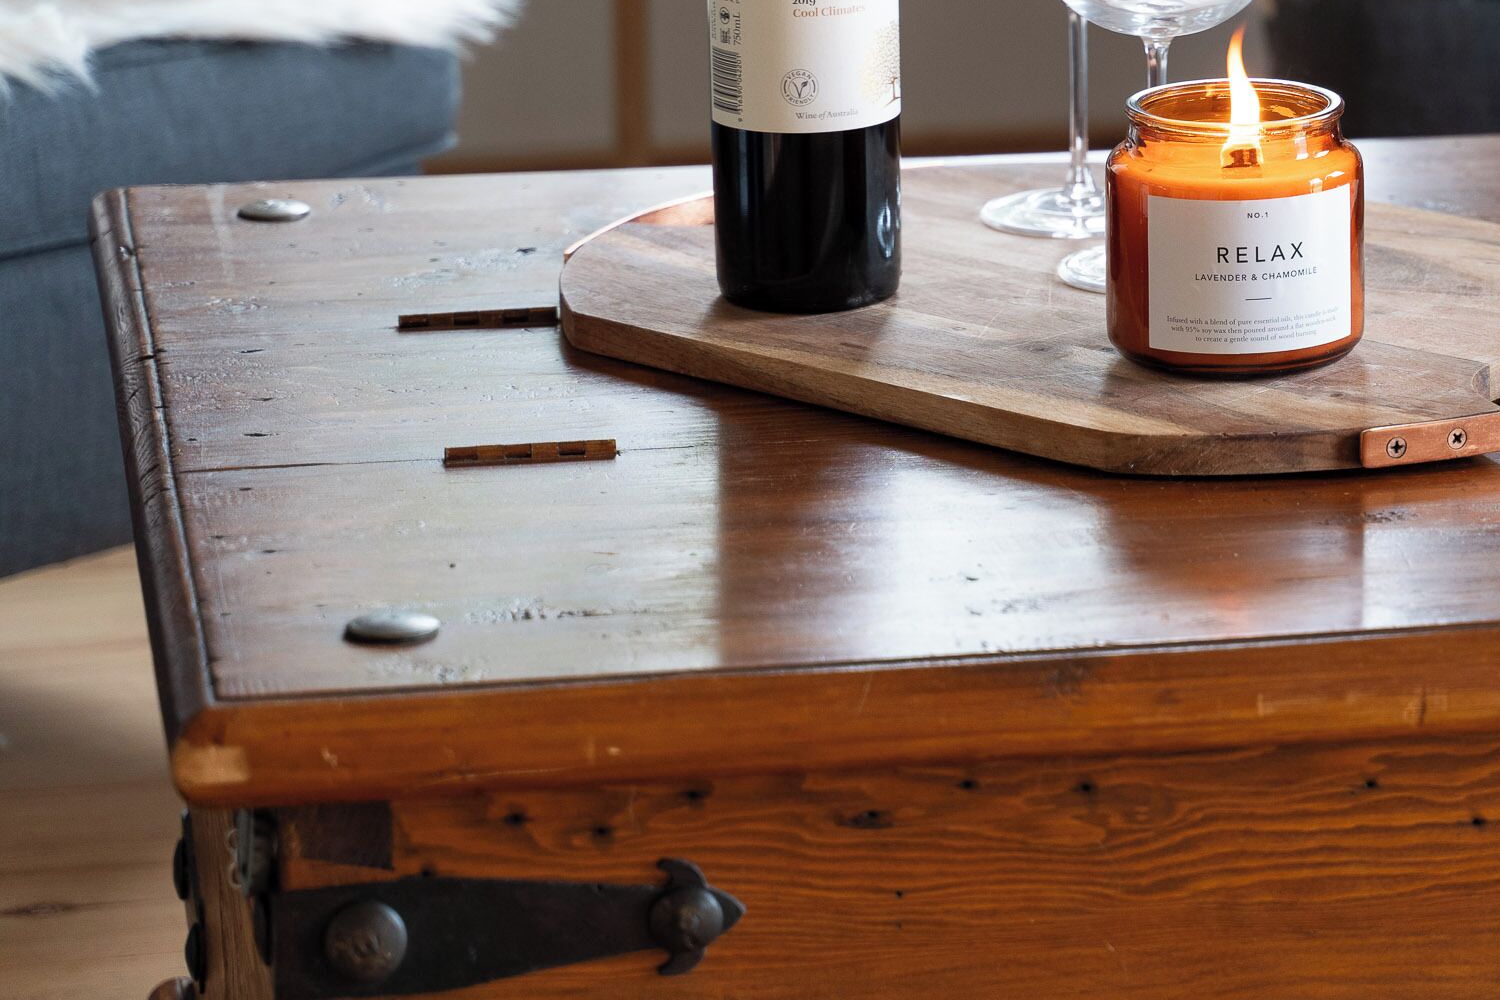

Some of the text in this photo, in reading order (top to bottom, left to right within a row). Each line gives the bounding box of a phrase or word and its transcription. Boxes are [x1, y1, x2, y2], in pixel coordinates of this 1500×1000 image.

[793, 7, 819, 18] Cool
[733, 12, 743, 45] 750mL
[786, 70, 812, 80] VEGAN
[785, 93, 814, 105] FRIENDLY
[795, 111, 816, 120] Wine
[818, 111, 827, 121] of
[1216, 241, 1303, 264] RELAX
[1195, 266, 1317, 282] LAVENDER & CHAMOMILE
[1166, 315, 1188, 325] Infused
[1189, 317, 1203, 325] with
[1210, 318, 1228, 326] blend
[1229, 318, 1237, 326] of
[1237, 319, 1252, 327] pure
[1253, 316, 1280, 325] essential
[1171, 324, 1184, 332] with
[1243, 326, 1266, 335] poured
[1268, 324, 1289, 333] around
[1229, 335, 1249, 344] gentle
[1250, 334, 1269, 342] sound
[1278, 331, 1295, 339] wood
